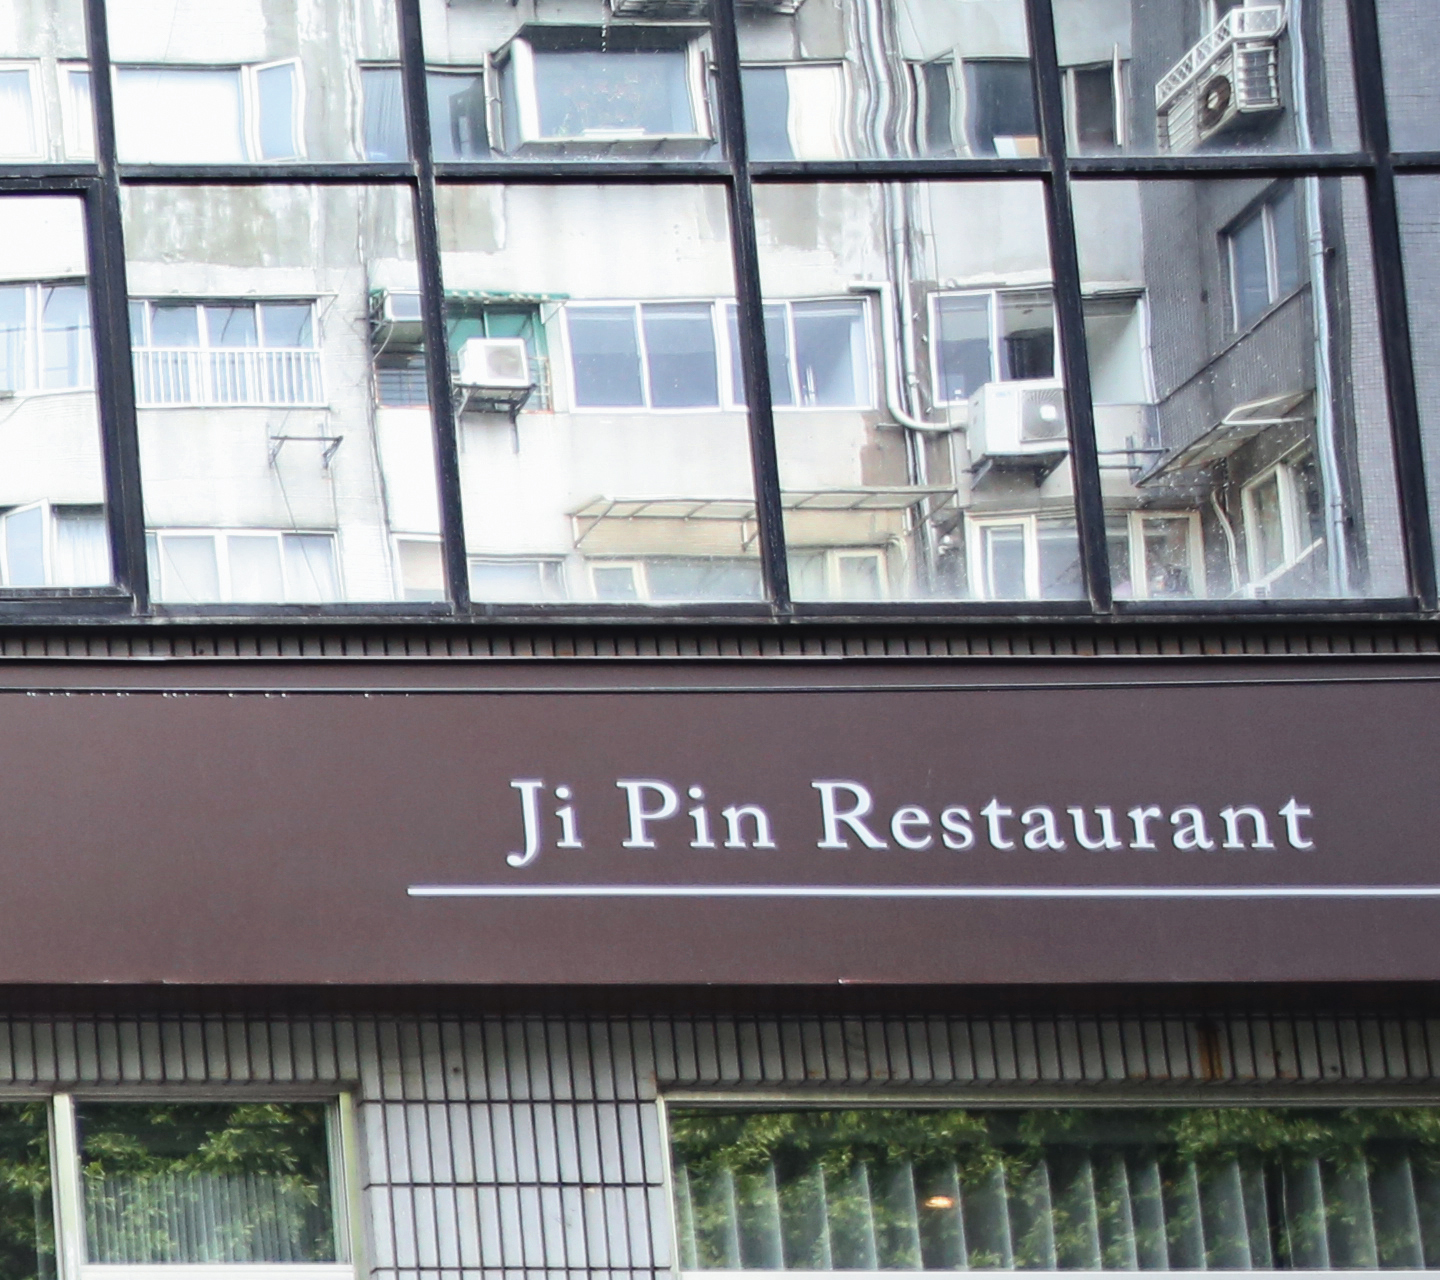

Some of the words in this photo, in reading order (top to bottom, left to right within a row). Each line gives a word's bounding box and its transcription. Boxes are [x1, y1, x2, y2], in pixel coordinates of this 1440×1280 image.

[506, 779, 583, 868] Ji
[616, 780, 777, 849] Pin
[811, 781, 1314, 850] Restaurant
